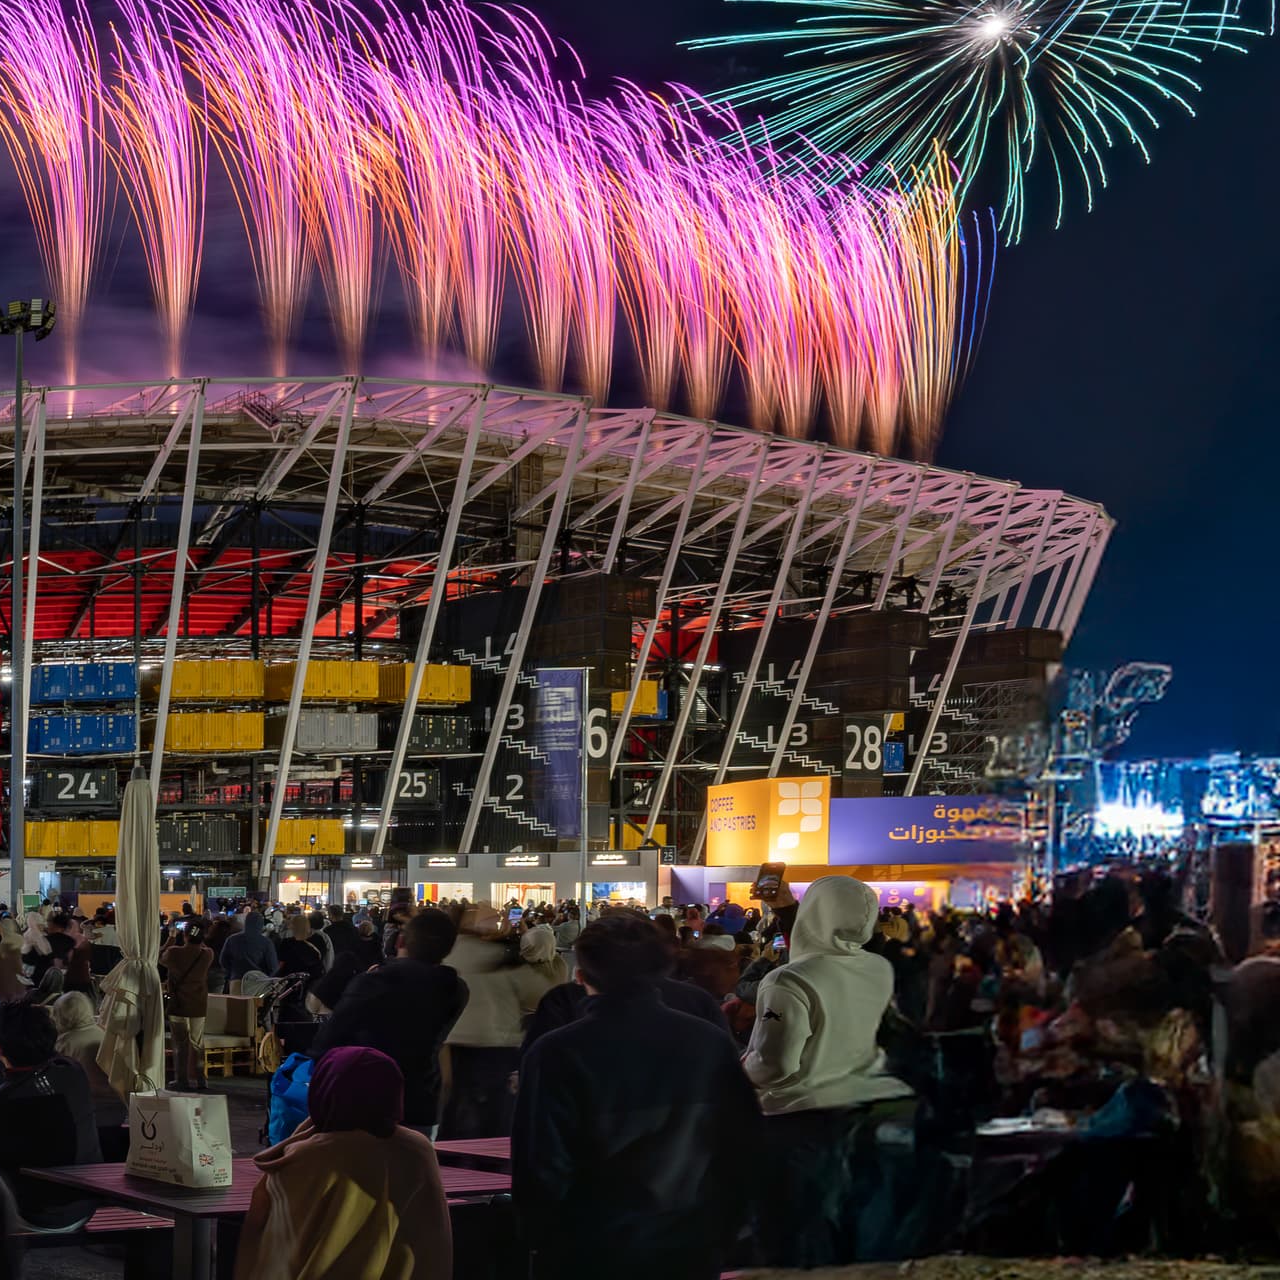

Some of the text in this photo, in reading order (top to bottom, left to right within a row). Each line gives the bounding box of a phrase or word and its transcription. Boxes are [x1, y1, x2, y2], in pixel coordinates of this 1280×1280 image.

[845, 724, 882, 770] 28
[57, 773, 99, 799] 24
[399, 772, 426, 798] 25
[710, 796, 734, 813] COFFEE
[724, 815, 756, 831] PASTRIES
[663, 852, 673, 861] 25
